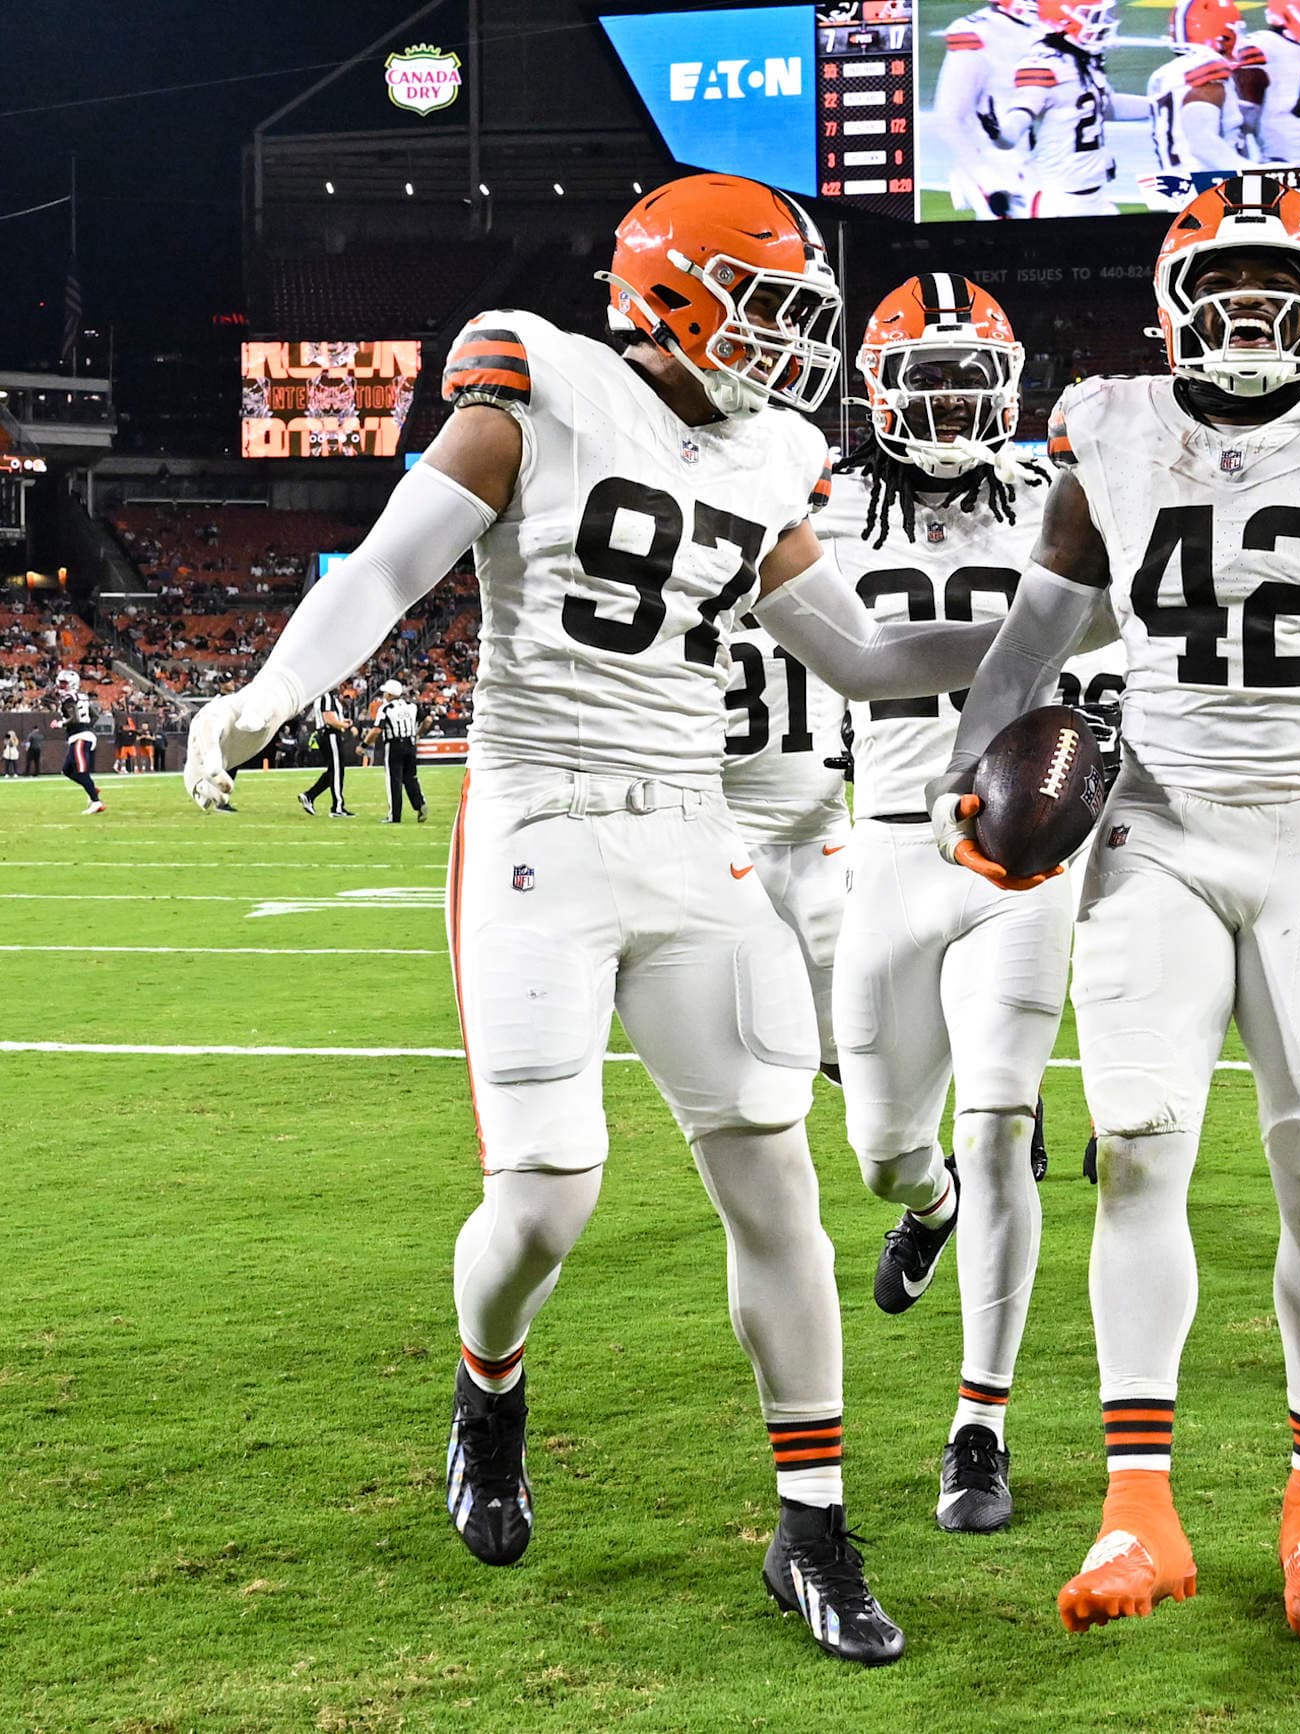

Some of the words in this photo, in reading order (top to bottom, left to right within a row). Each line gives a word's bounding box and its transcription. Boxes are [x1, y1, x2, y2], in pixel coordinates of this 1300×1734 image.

[824, 28, 836, 53] 7
[889, 25, 905, 49] 17
[388, 70, 459, 85] CANADA
[669, 56, 802, 101] EATON
[406, 86, 441, 100] DRY
[974, 270, 1008, 283] TEXT
[1017, 267, 1064, 282] ISSUES
[1071, 267, 1092, 280] TO
[561, 476, 767, 668] 97
